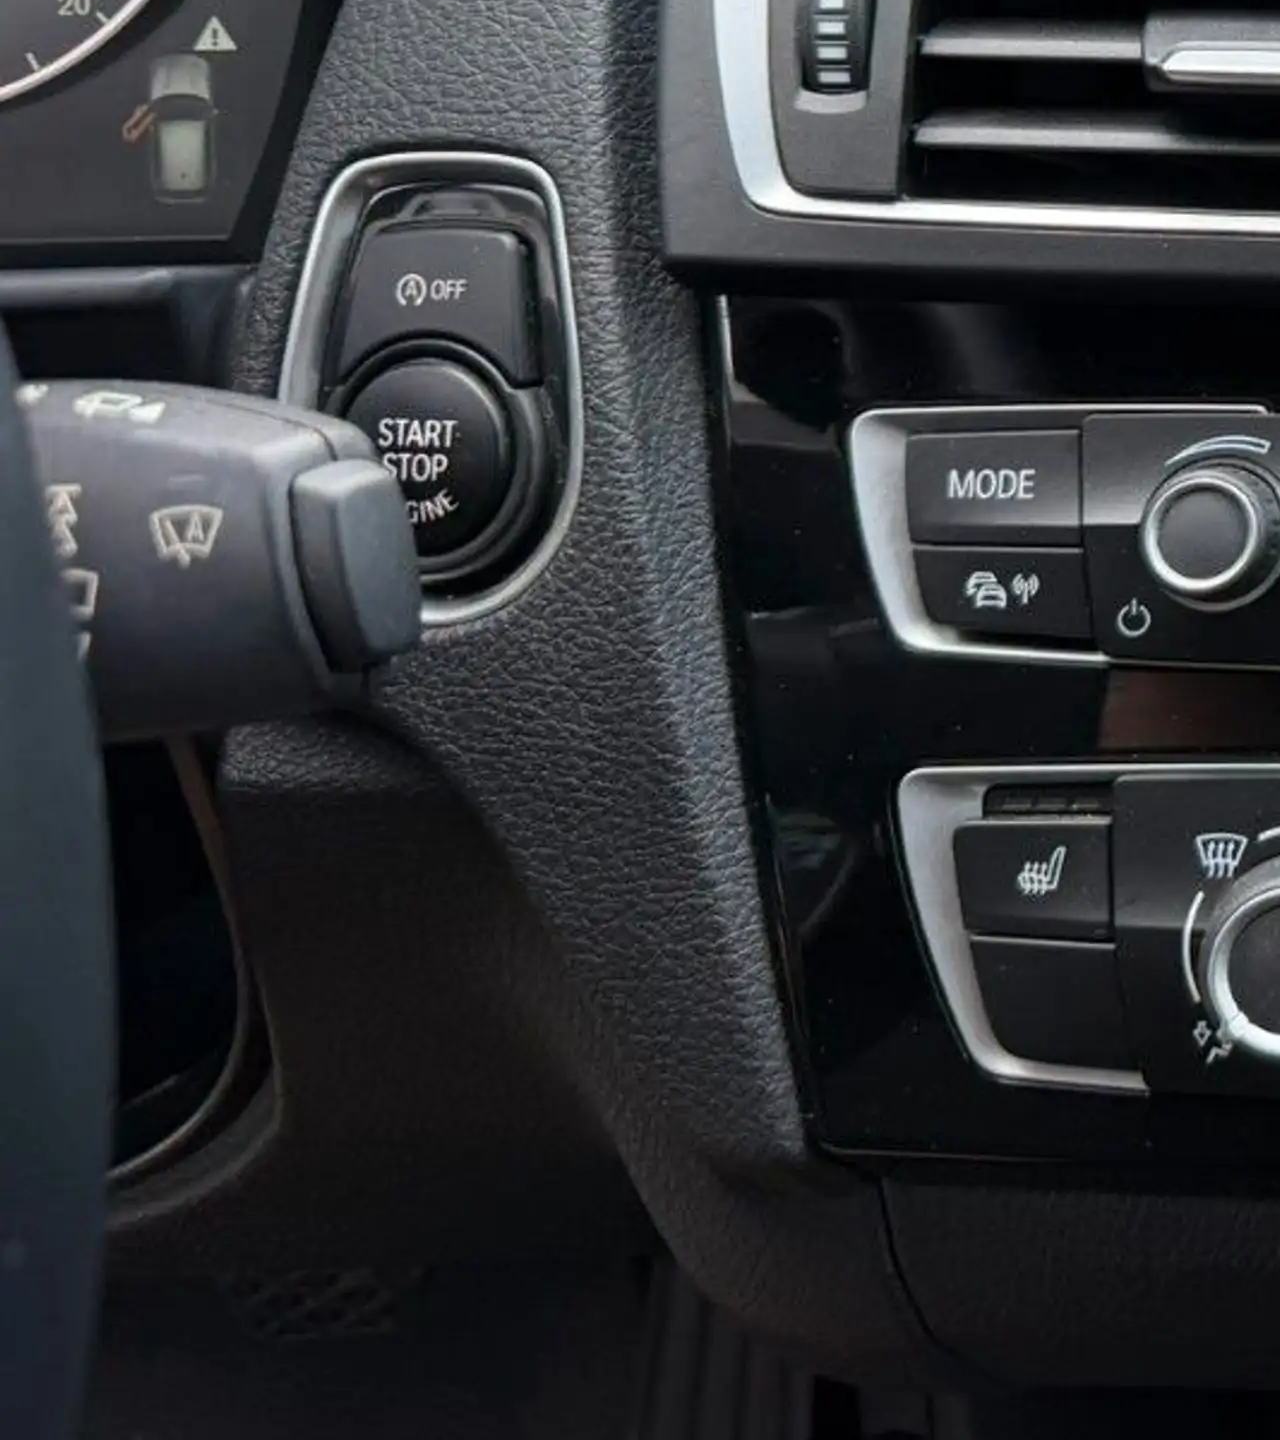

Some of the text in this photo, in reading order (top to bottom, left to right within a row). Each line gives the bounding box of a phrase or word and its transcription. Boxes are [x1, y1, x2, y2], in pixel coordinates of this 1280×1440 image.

[430, 278, 468, 301] OFF
[378, 417, 458, 449] START
[383, 452, 449, 482] STOP
[947, 467, 1036, 501] MODE
[405, 487, 460, 524] GINE
